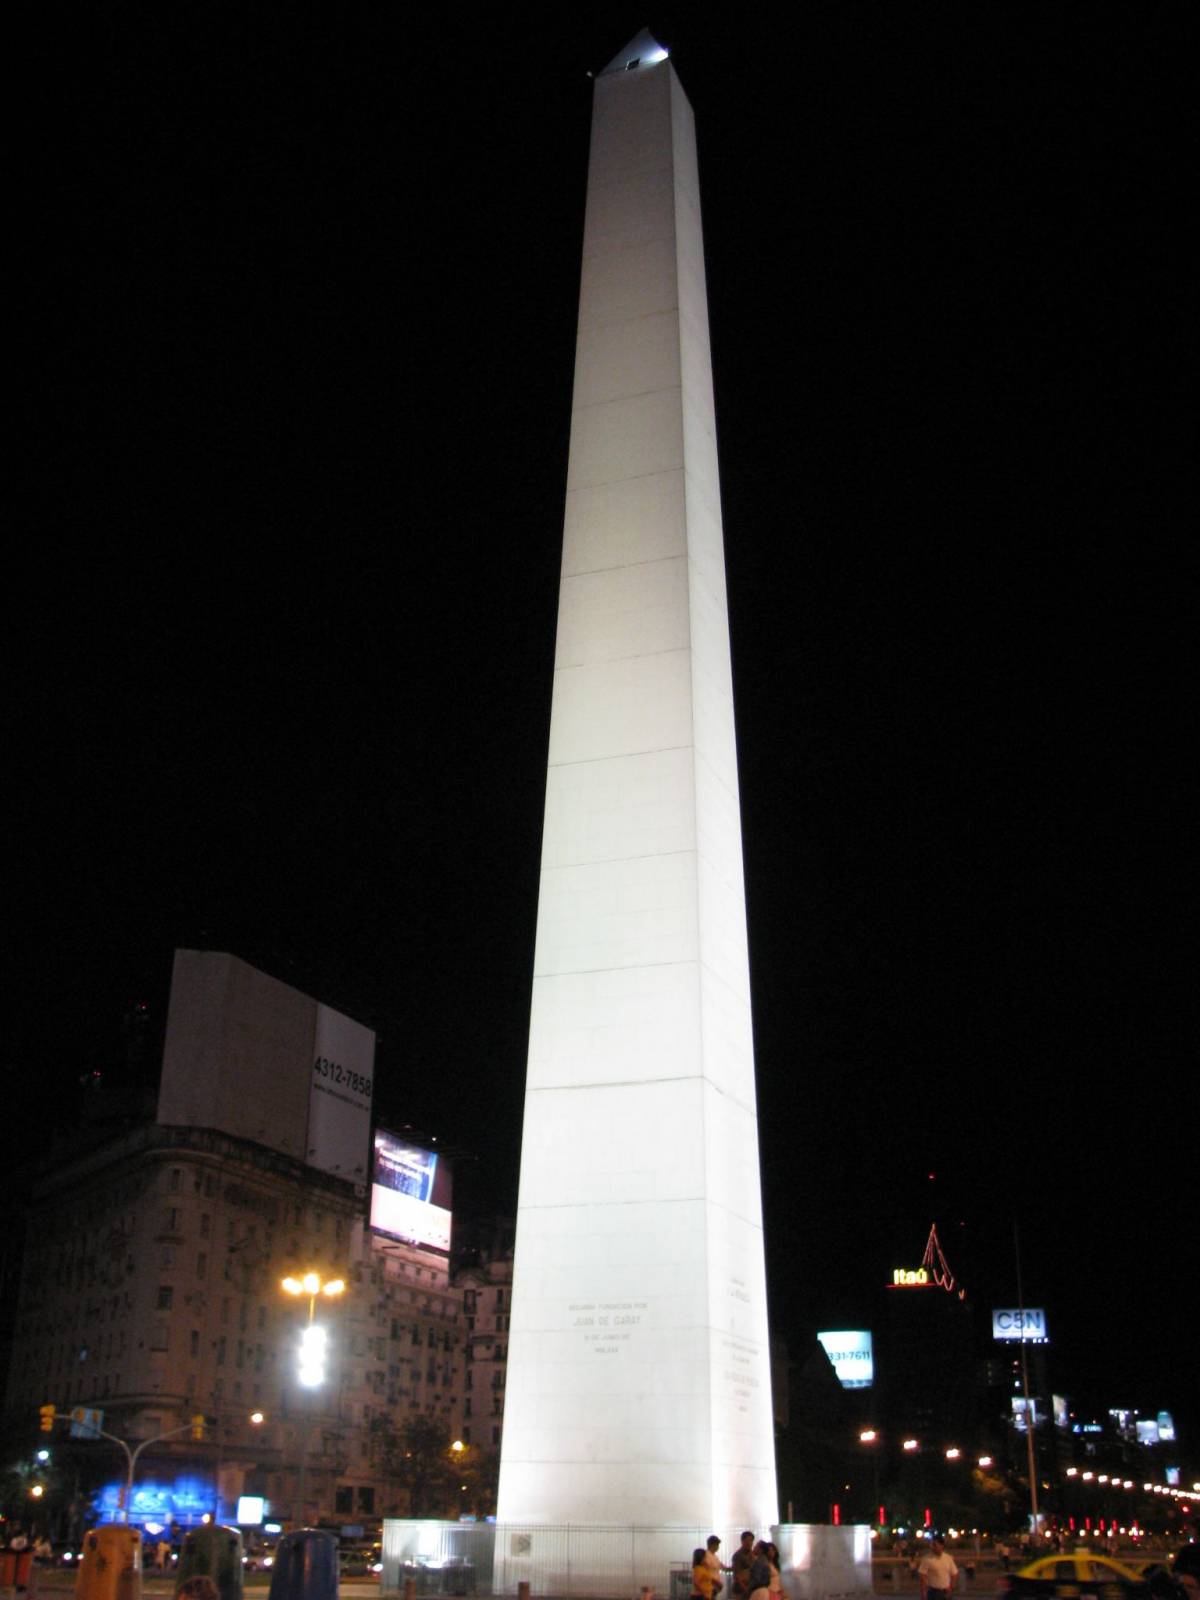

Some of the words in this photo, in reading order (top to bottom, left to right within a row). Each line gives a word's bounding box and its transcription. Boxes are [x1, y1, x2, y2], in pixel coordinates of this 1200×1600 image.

[314, 1055, 371, 1097] 4312-7858
[894, 1267, 928, 1285] Itaú
[599, 1315, 609, 1326] DE
[997, 1311, 1040, 1330] C5N
